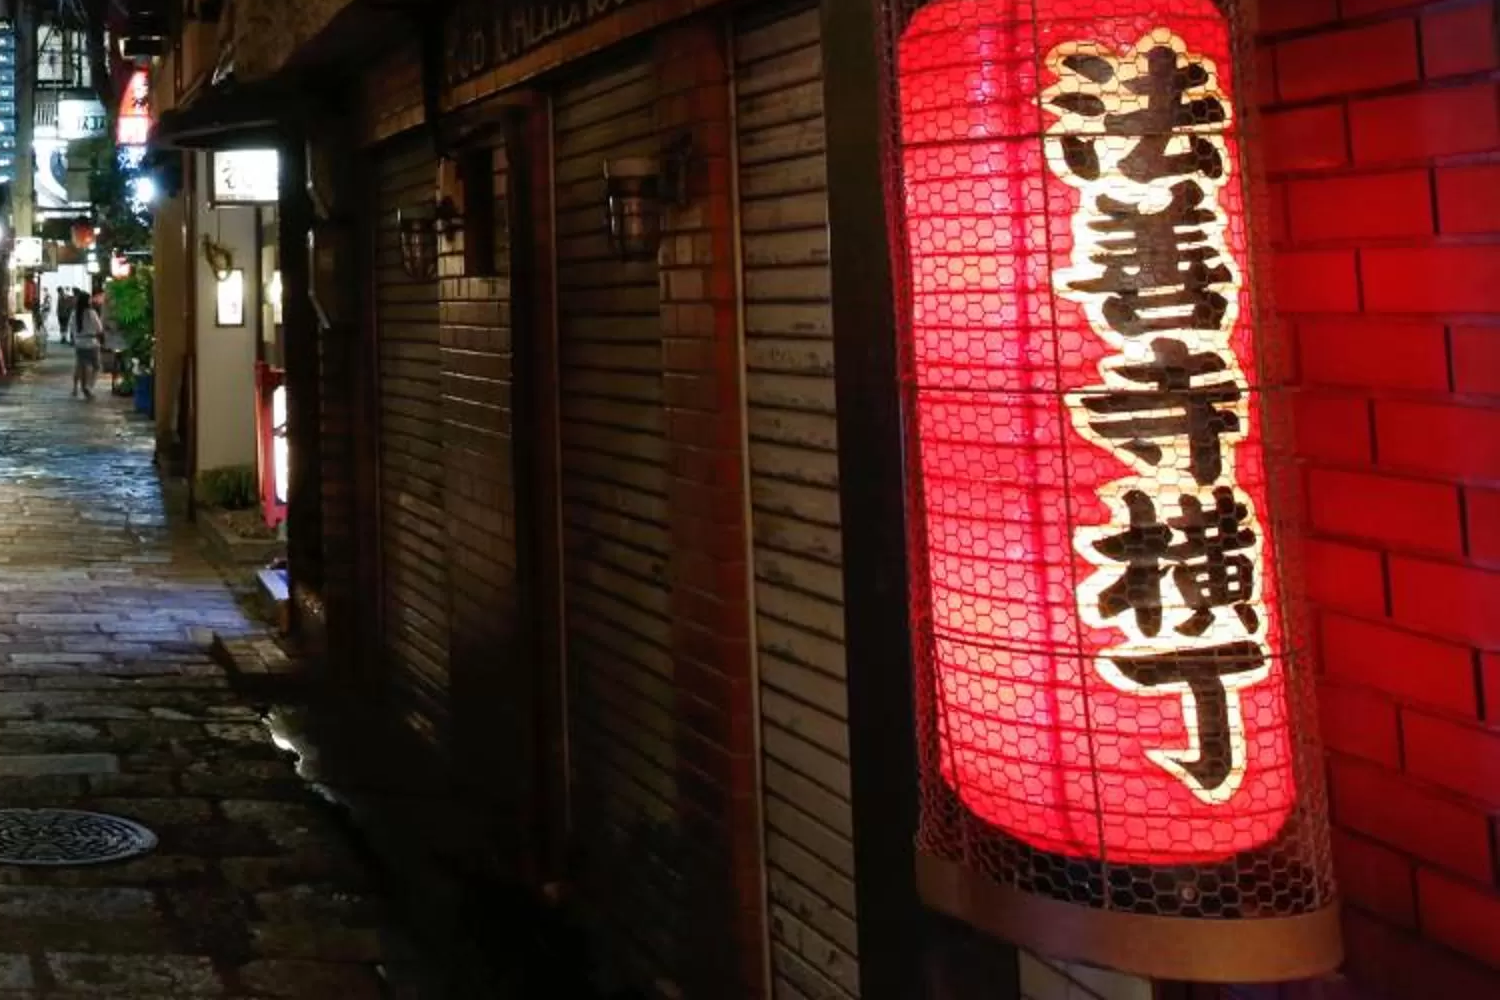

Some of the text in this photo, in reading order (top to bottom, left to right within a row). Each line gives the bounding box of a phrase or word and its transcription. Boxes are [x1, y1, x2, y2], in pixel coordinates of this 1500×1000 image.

[1054, 42, 1268, 792] 法善寺横丁
